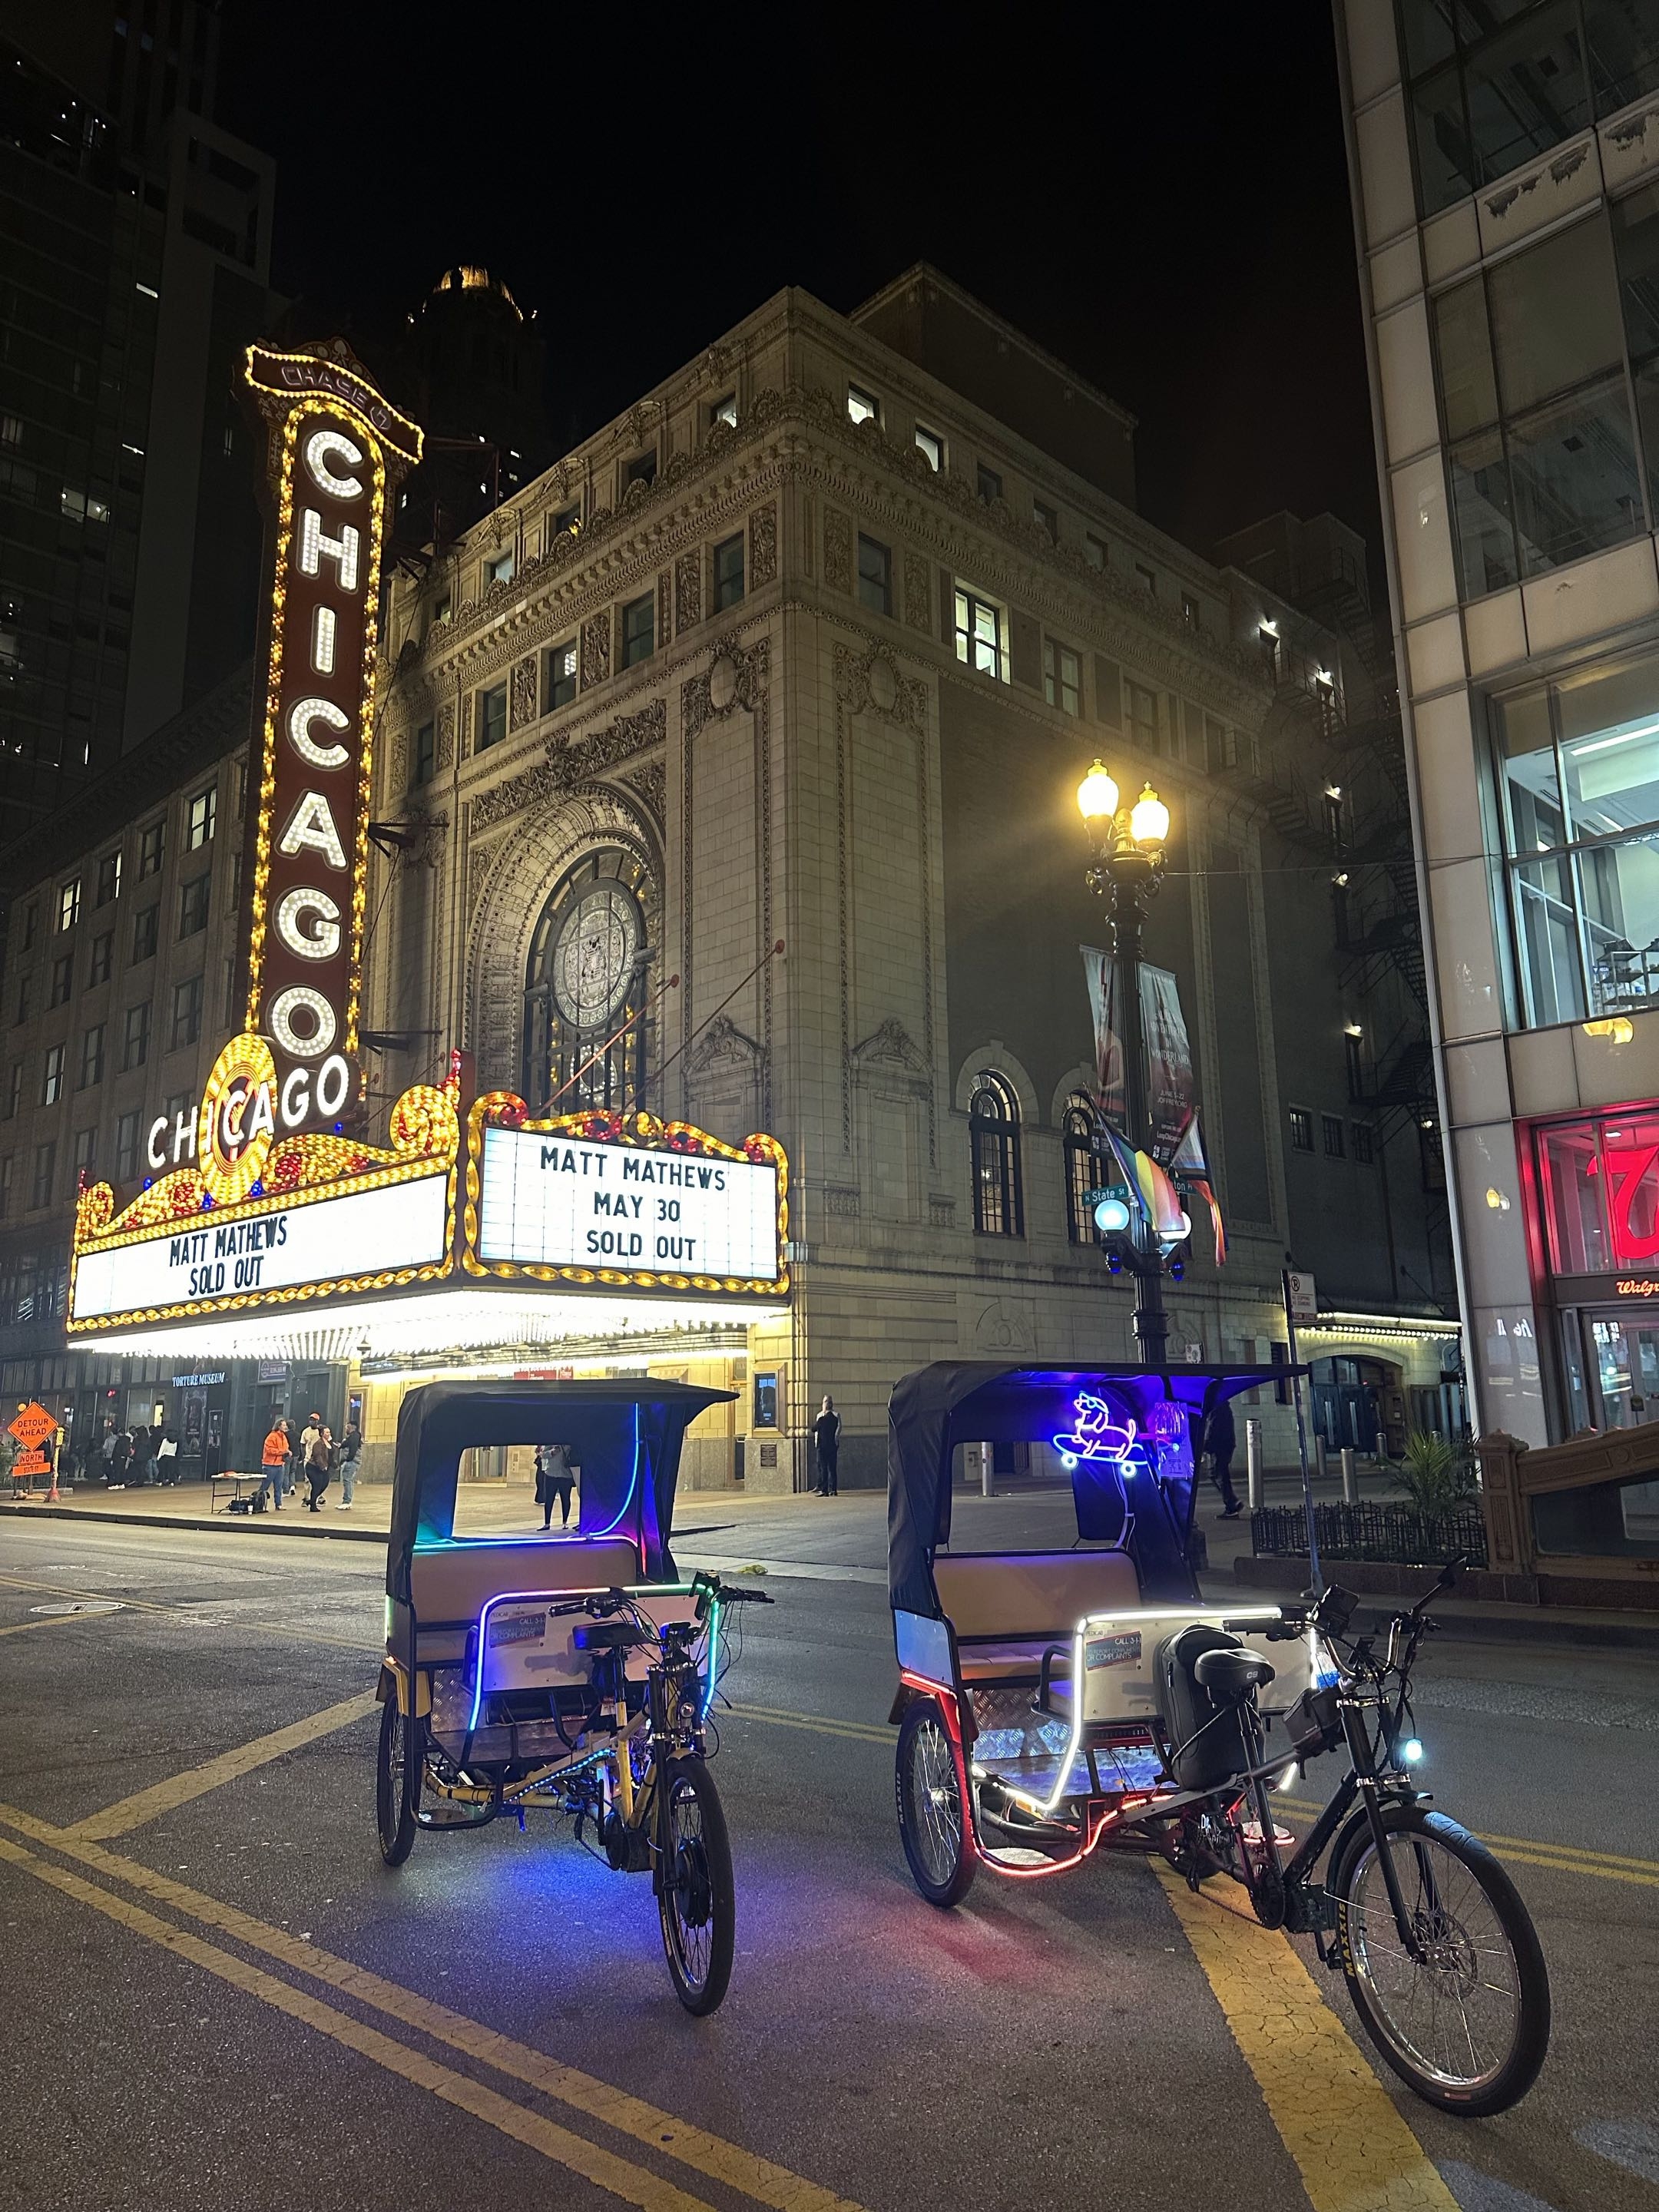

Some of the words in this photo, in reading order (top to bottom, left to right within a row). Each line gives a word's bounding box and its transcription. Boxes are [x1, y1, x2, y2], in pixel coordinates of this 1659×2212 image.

[280, 365, 369, 410] CHASE
[272, 430, 363, 1057] CHICAGO
[148, 1055, 349, 1168] CHICAGO
[541, 1145, 608, 1177] MATT
[623, 1157, 726, 1190] MATHEWS
[594, 1191, 644, 1218] MAY
[657, 1198, 680, 1222] 30
[1091, 1187, 1115, 1202] State
[1118, 1187, 1125, 1195] St
[169, 1233, 209, 1267] MATT
[214, 1215, 288, 1258] MATHEWS
[586, 1230, 643, 1257] SOLD
[656, 1236, 697, 1261] OUT
[188, 1262, 225, 1296] SOLD
[234, 1255, 264, 1289] OUT
[172, 1375, 199, 1387] TORTURE
[199, 1373, 225, 1386] MUSEUM
[18, 1418, 49, 1428] DETOUR
[19, 1428, 47, 1437] AHEAD
[1095, 1652, 1132, 1661] COMPLAINTS
[1114, 1637, 1129, 1645] CALL
[896, 1772, 905, 1824] MAXXIS
[1339, 1902, 1356, 1977] MAXXIS
